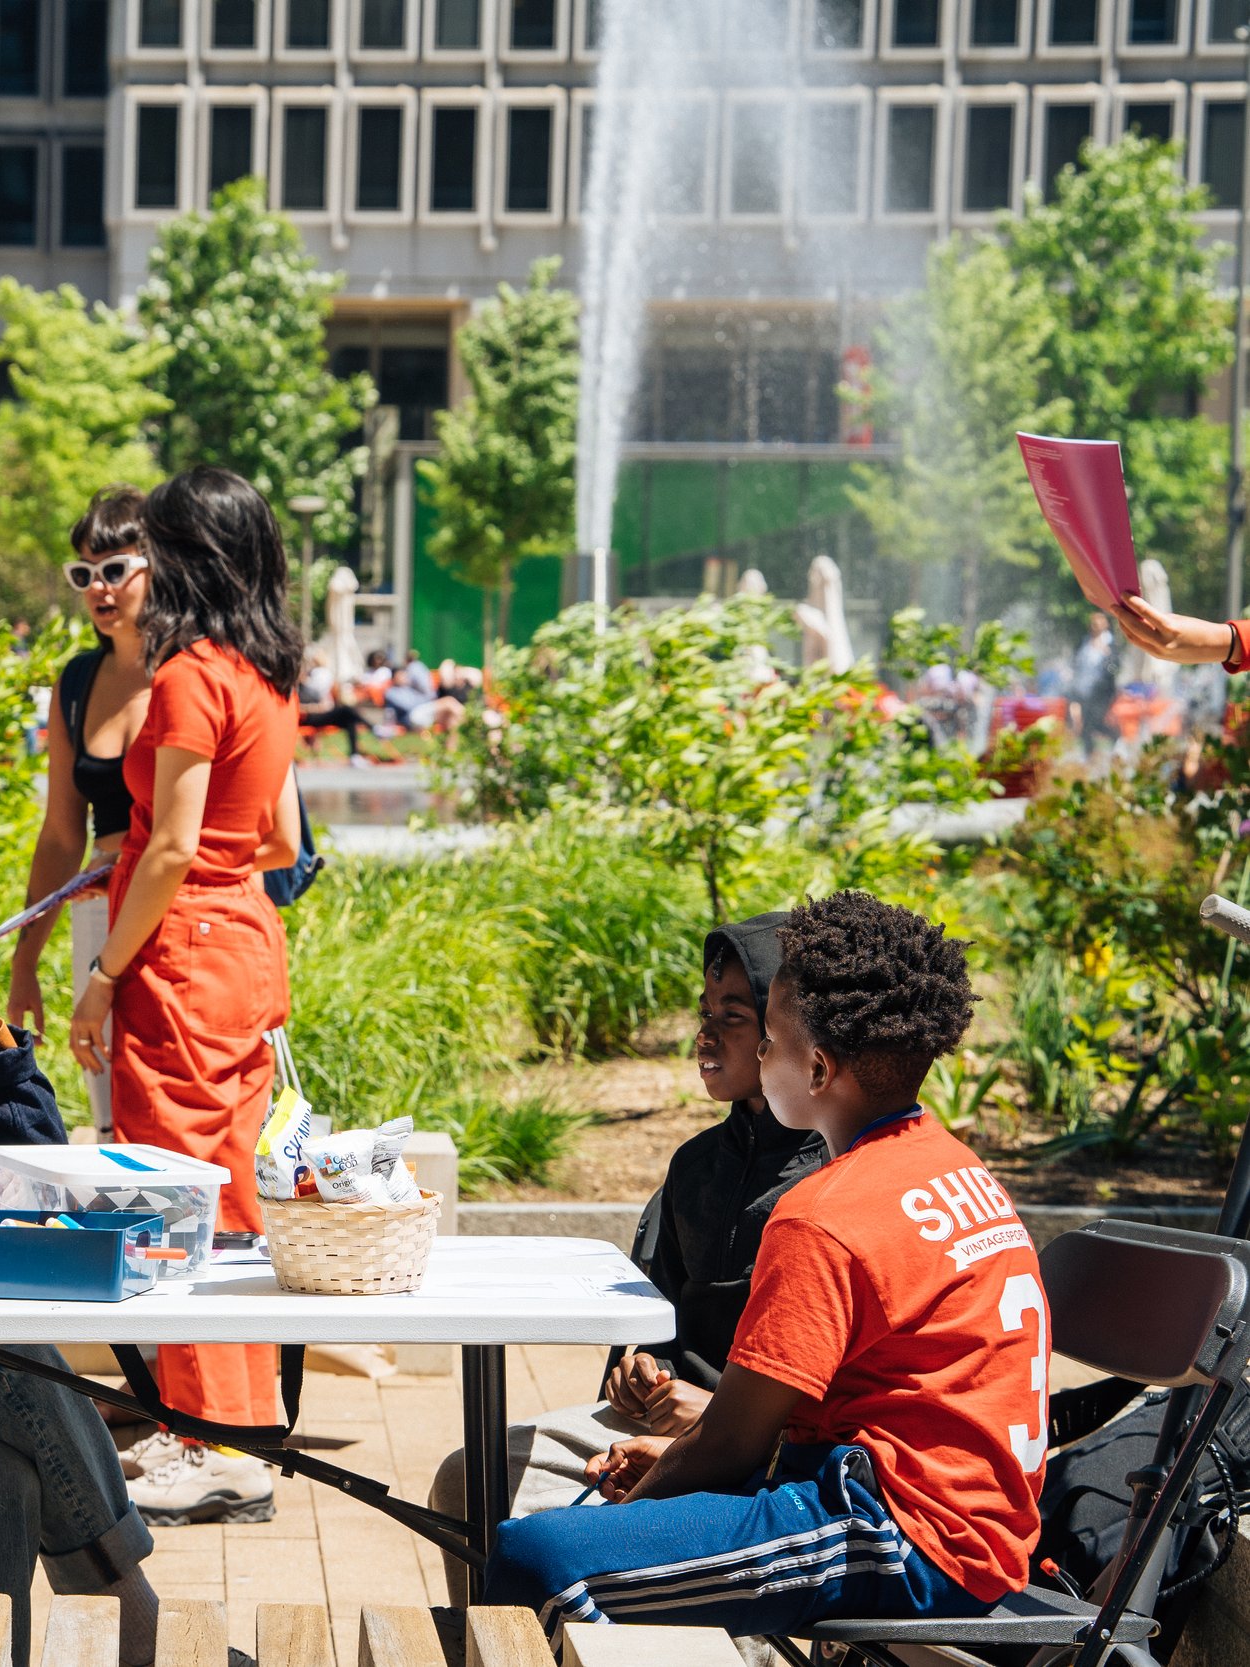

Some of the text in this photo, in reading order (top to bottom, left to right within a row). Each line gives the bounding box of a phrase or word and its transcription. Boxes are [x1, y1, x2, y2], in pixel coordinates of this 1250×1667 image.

[333, 1151, 357, 1165] CAPE
[338, 1159, 359, 1171] COD
[961, 1232, 1005, 1257] VINTAGE
[998, 1273, 1048, 1473] 3
